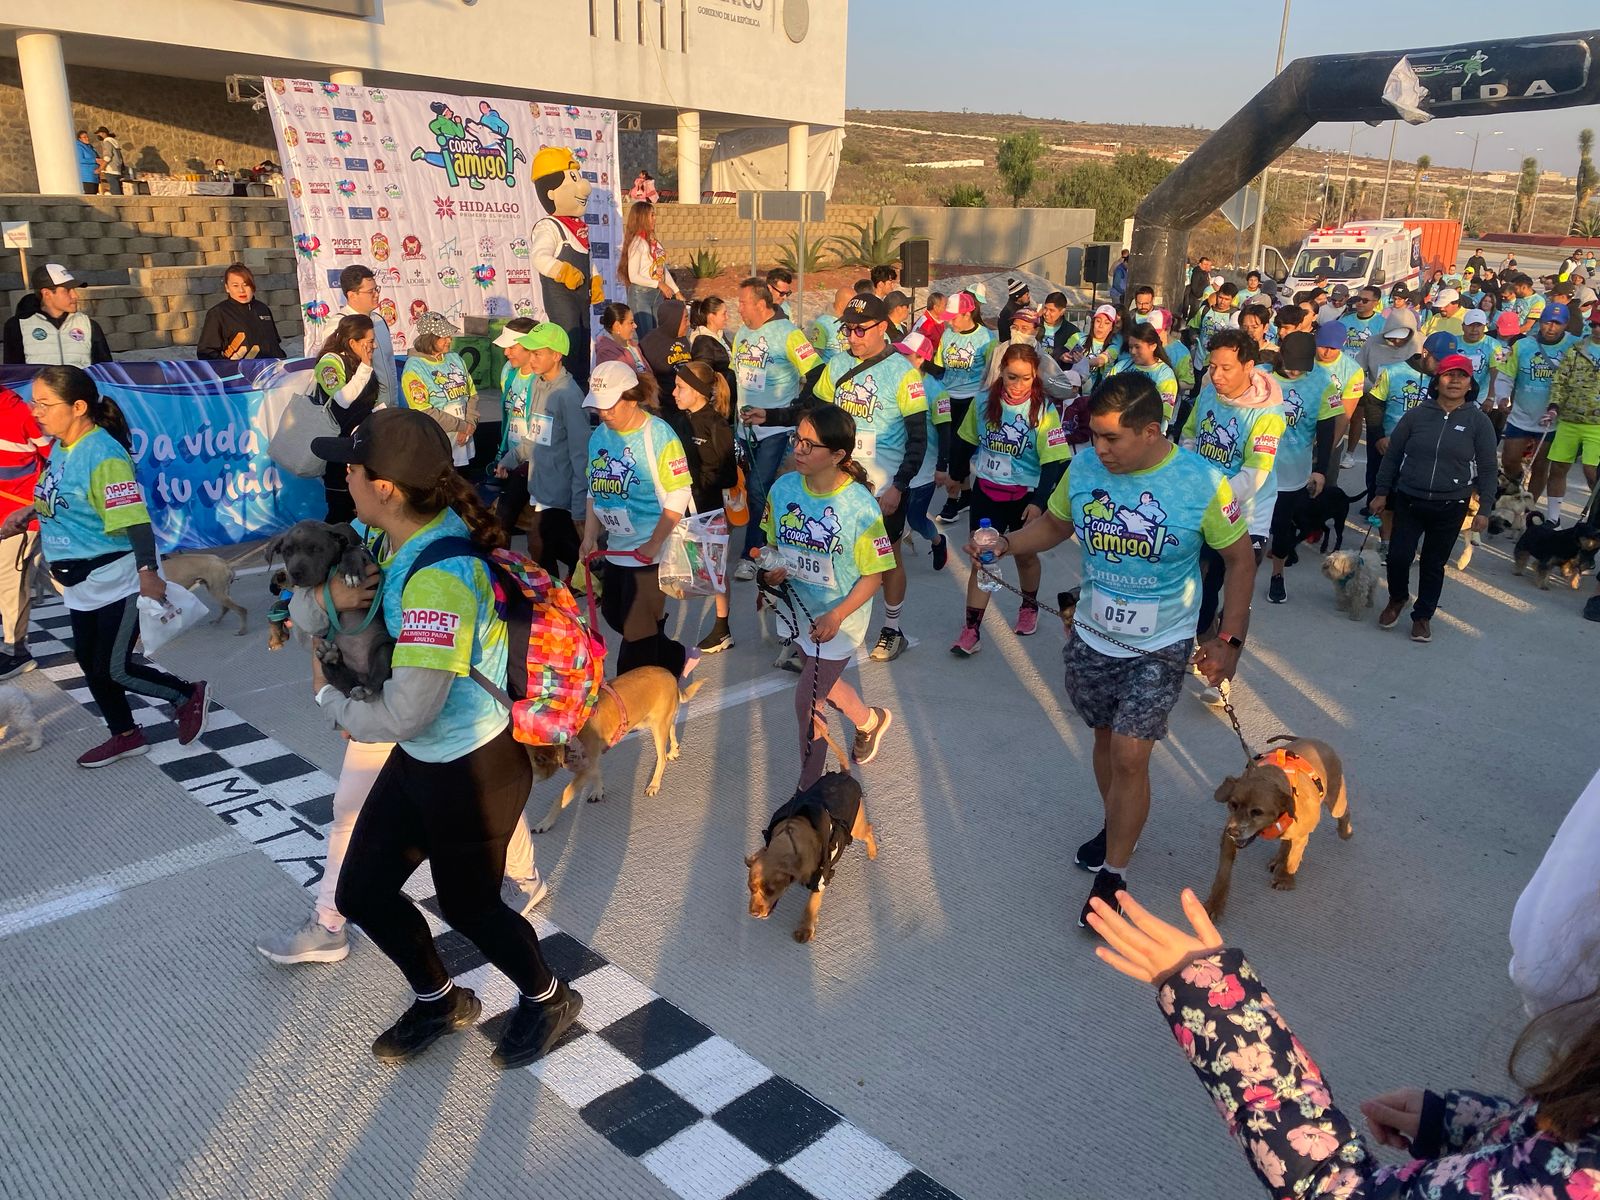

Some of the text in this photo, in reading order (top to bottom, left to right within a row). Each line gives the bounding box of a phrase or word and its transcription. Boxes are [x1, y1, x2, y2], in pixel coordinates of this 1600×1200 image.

[697, 6, 761, 27] GOBIERNO DE LA REPÚBLICA
[459, 200, 520, 213] HIDALGO
[331, 238, 362, 246] DINAPET
[461, 346, 481, 385] 2
[131, 419, 260, 464] Da vida
[157, 463, 283, 503] tu vida
[603, 515, 620, 528] 064
[797, 556, 820, 573] 056
[1097, 570, 1159, 586] HIDALGO
[1105, 605, 1137, 625] 057
[186, 776, 328, 888] META
